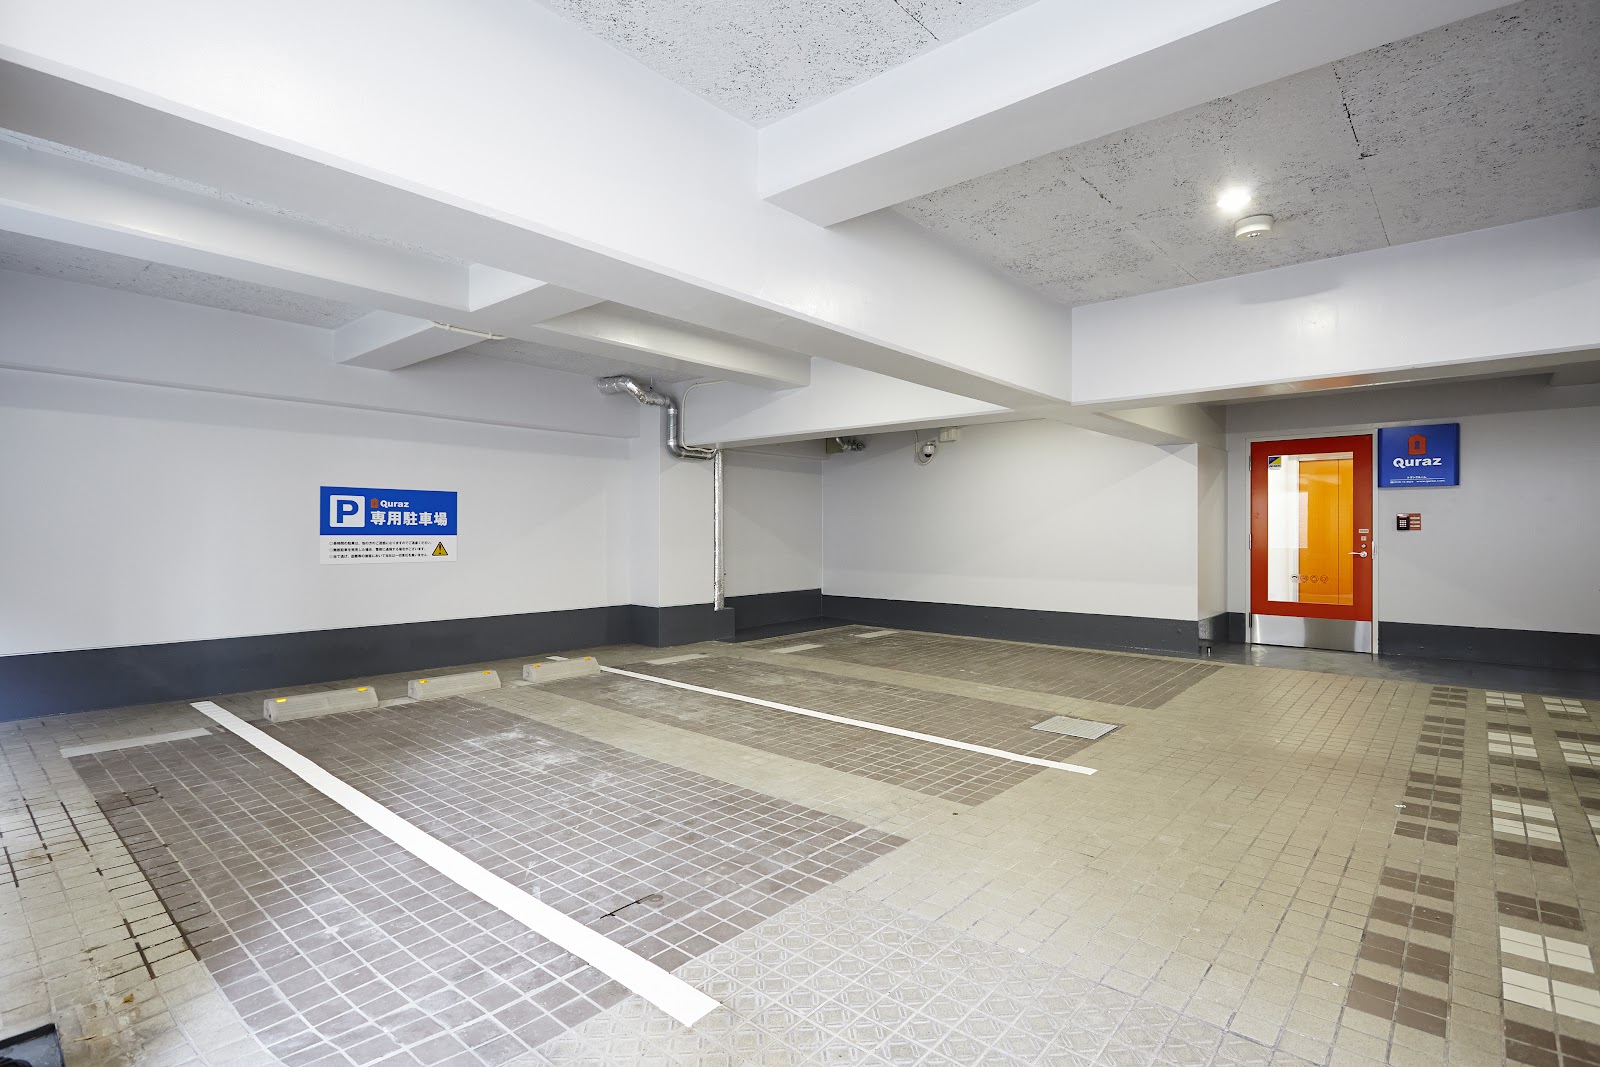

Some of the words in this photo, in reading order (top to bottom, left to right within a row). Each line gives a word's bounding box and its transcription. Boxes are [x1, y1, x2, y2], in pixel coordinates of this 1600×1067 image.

[1393, 457, 1442, 469] Quraz
[380, 500, 410, 508] Quraz
[336, 499, 359, 524] P
[370, 511, 448, 526] 専用駐車場
